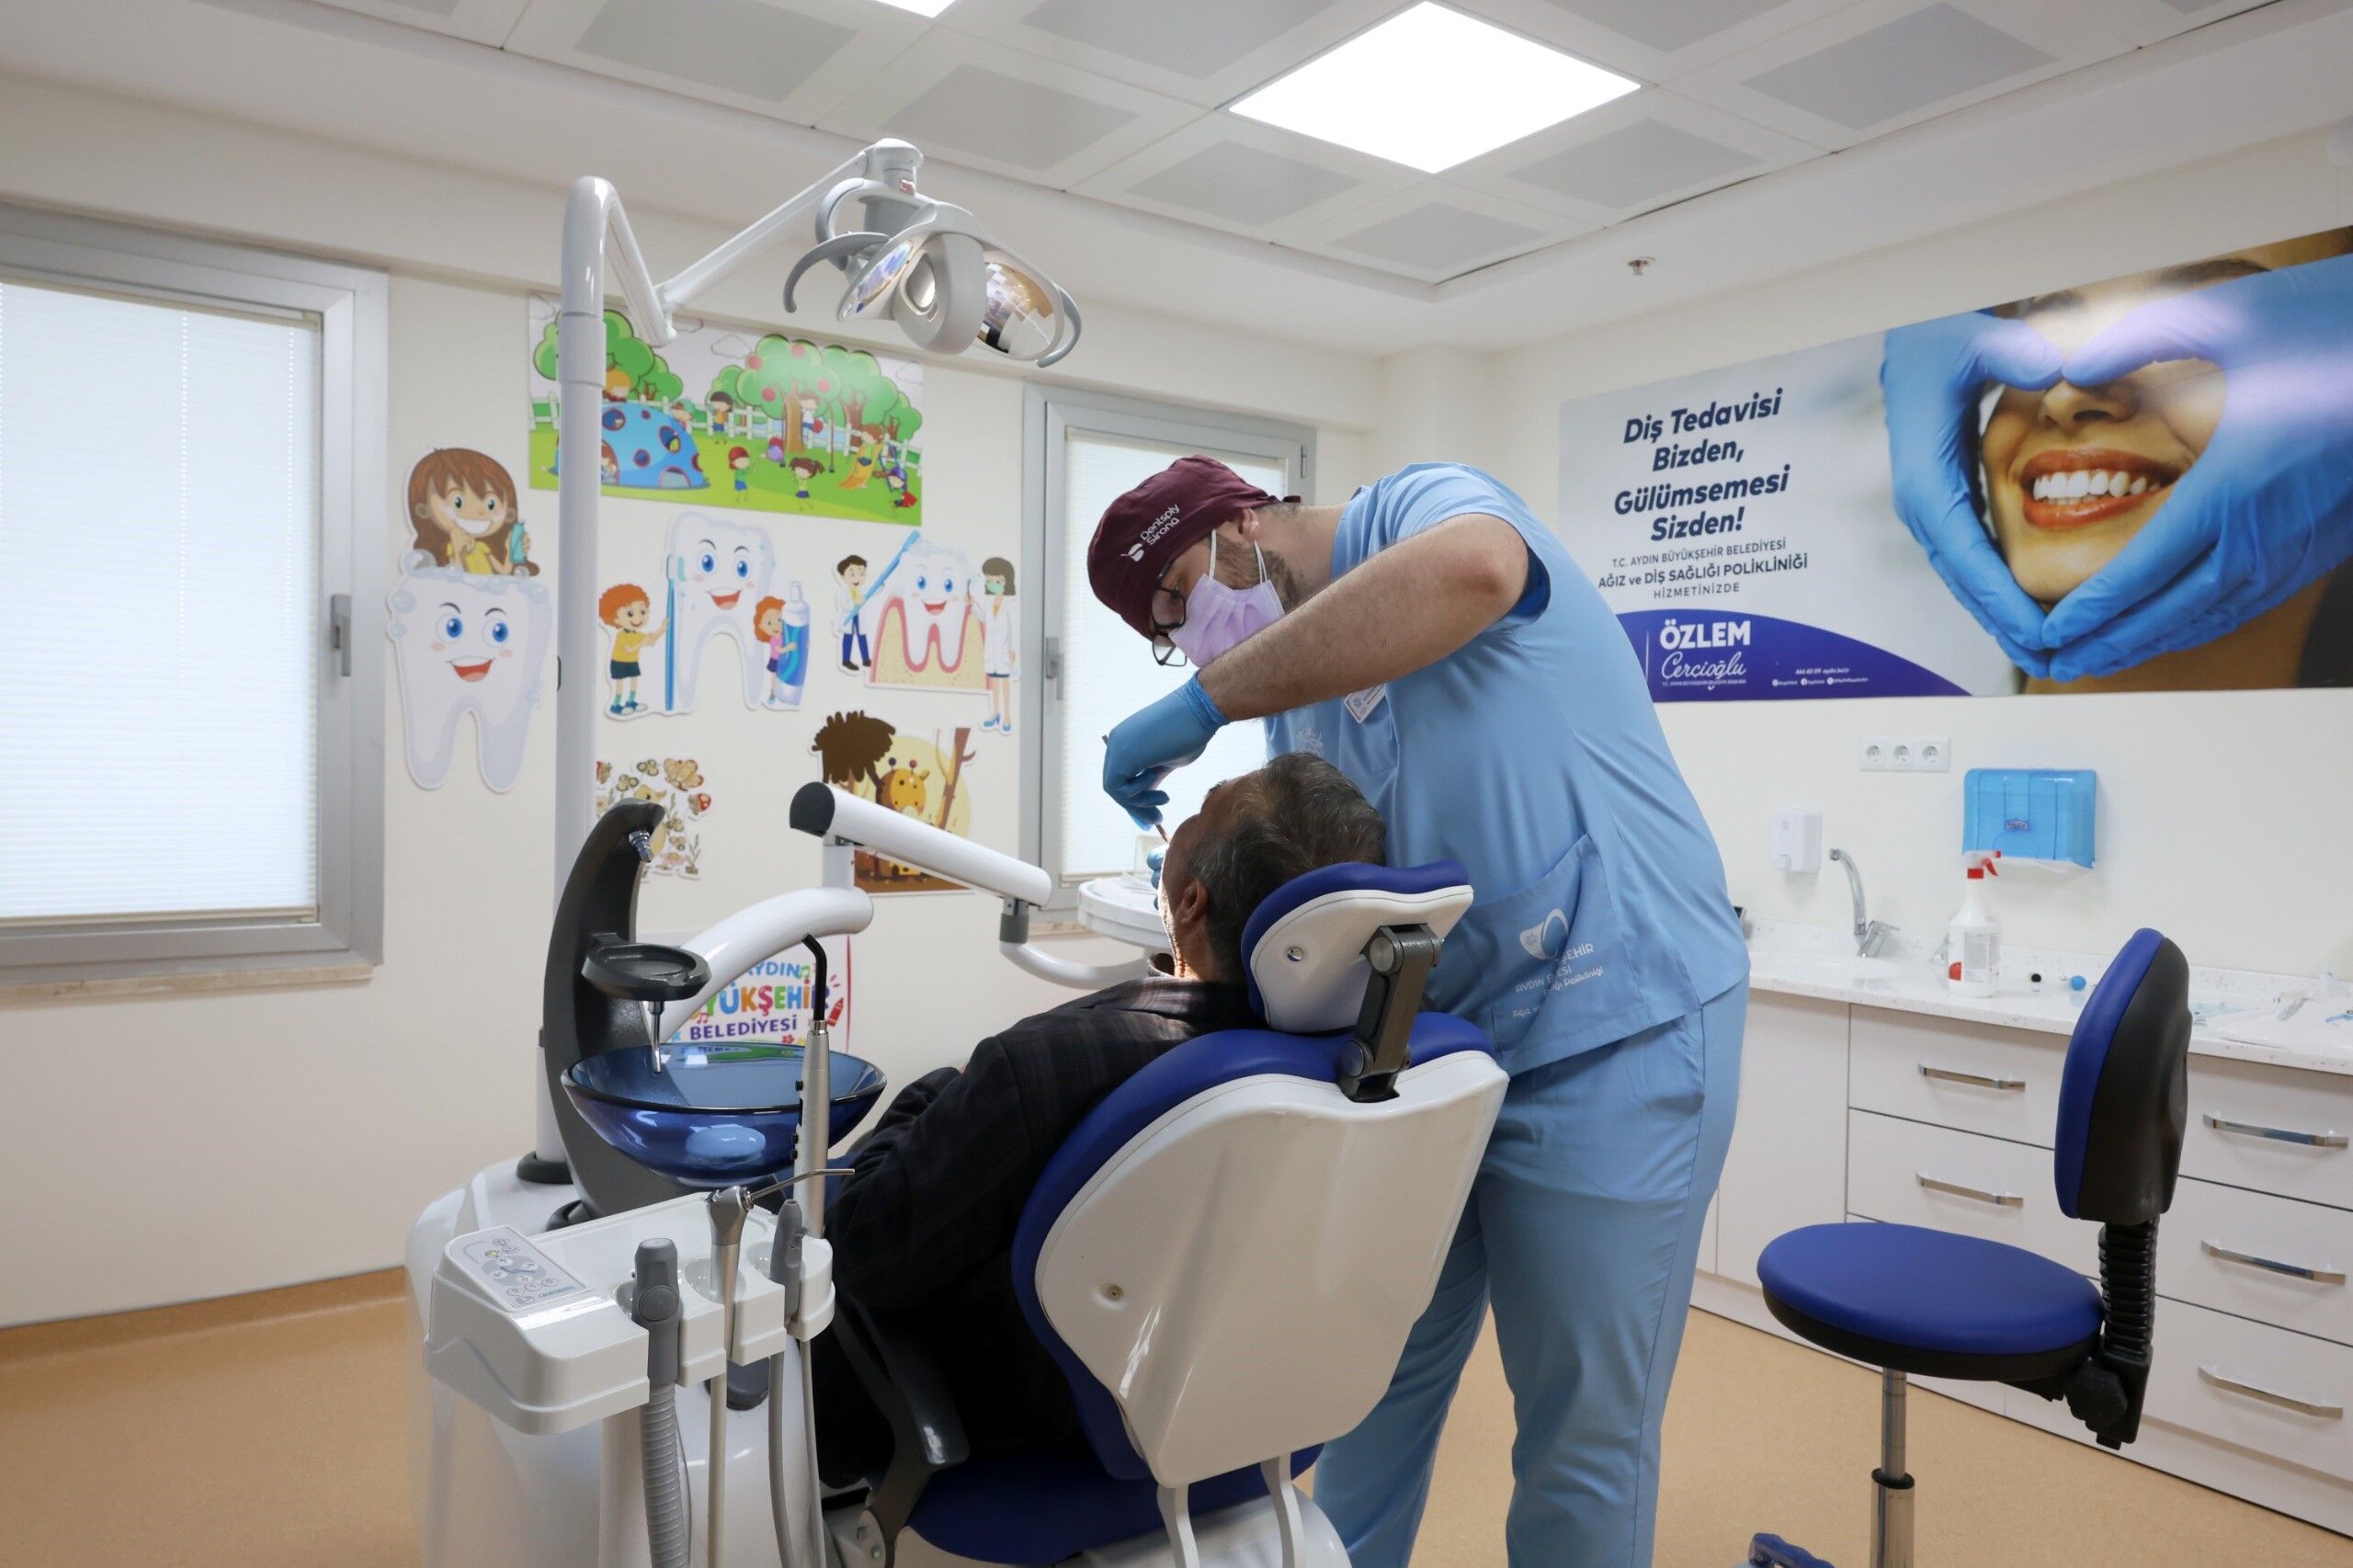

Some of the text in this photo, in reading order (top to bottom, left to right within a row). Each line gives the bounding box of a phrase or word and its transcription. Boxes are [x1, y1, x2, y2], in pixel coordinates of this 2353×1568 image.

[1623, 387, 1783, 443] Diş Tedavisi
[1653, 438, 1745, 472] Bizden,
[1614, 463, 1790, 515] Gülümsemesi
[1141, 504, 1179, 540] Dentsply
[1147, 517, 1180, 545] Sirona
[1651, 506, 1745, 541] Sizden!
[1612, 537, 1786, 568] T.C. AYDIN BÜYÜKŞEHİR BELEDİYESİ
[1598, 552, 1808, 588] AĞIZ ve DİŞ SAĞLIĞI POLİKLİNİĞİ
[1654, 582, 1740, 598] HİZMETİNİZDE
[1659, 618, 1751, 651] ÖZLEM
[1661, 651, 1747, 680] Cercioğlu
[747, 961, 801, 977] YDIN
[689, 1014, 797, 1041] BELEDİYESİ
